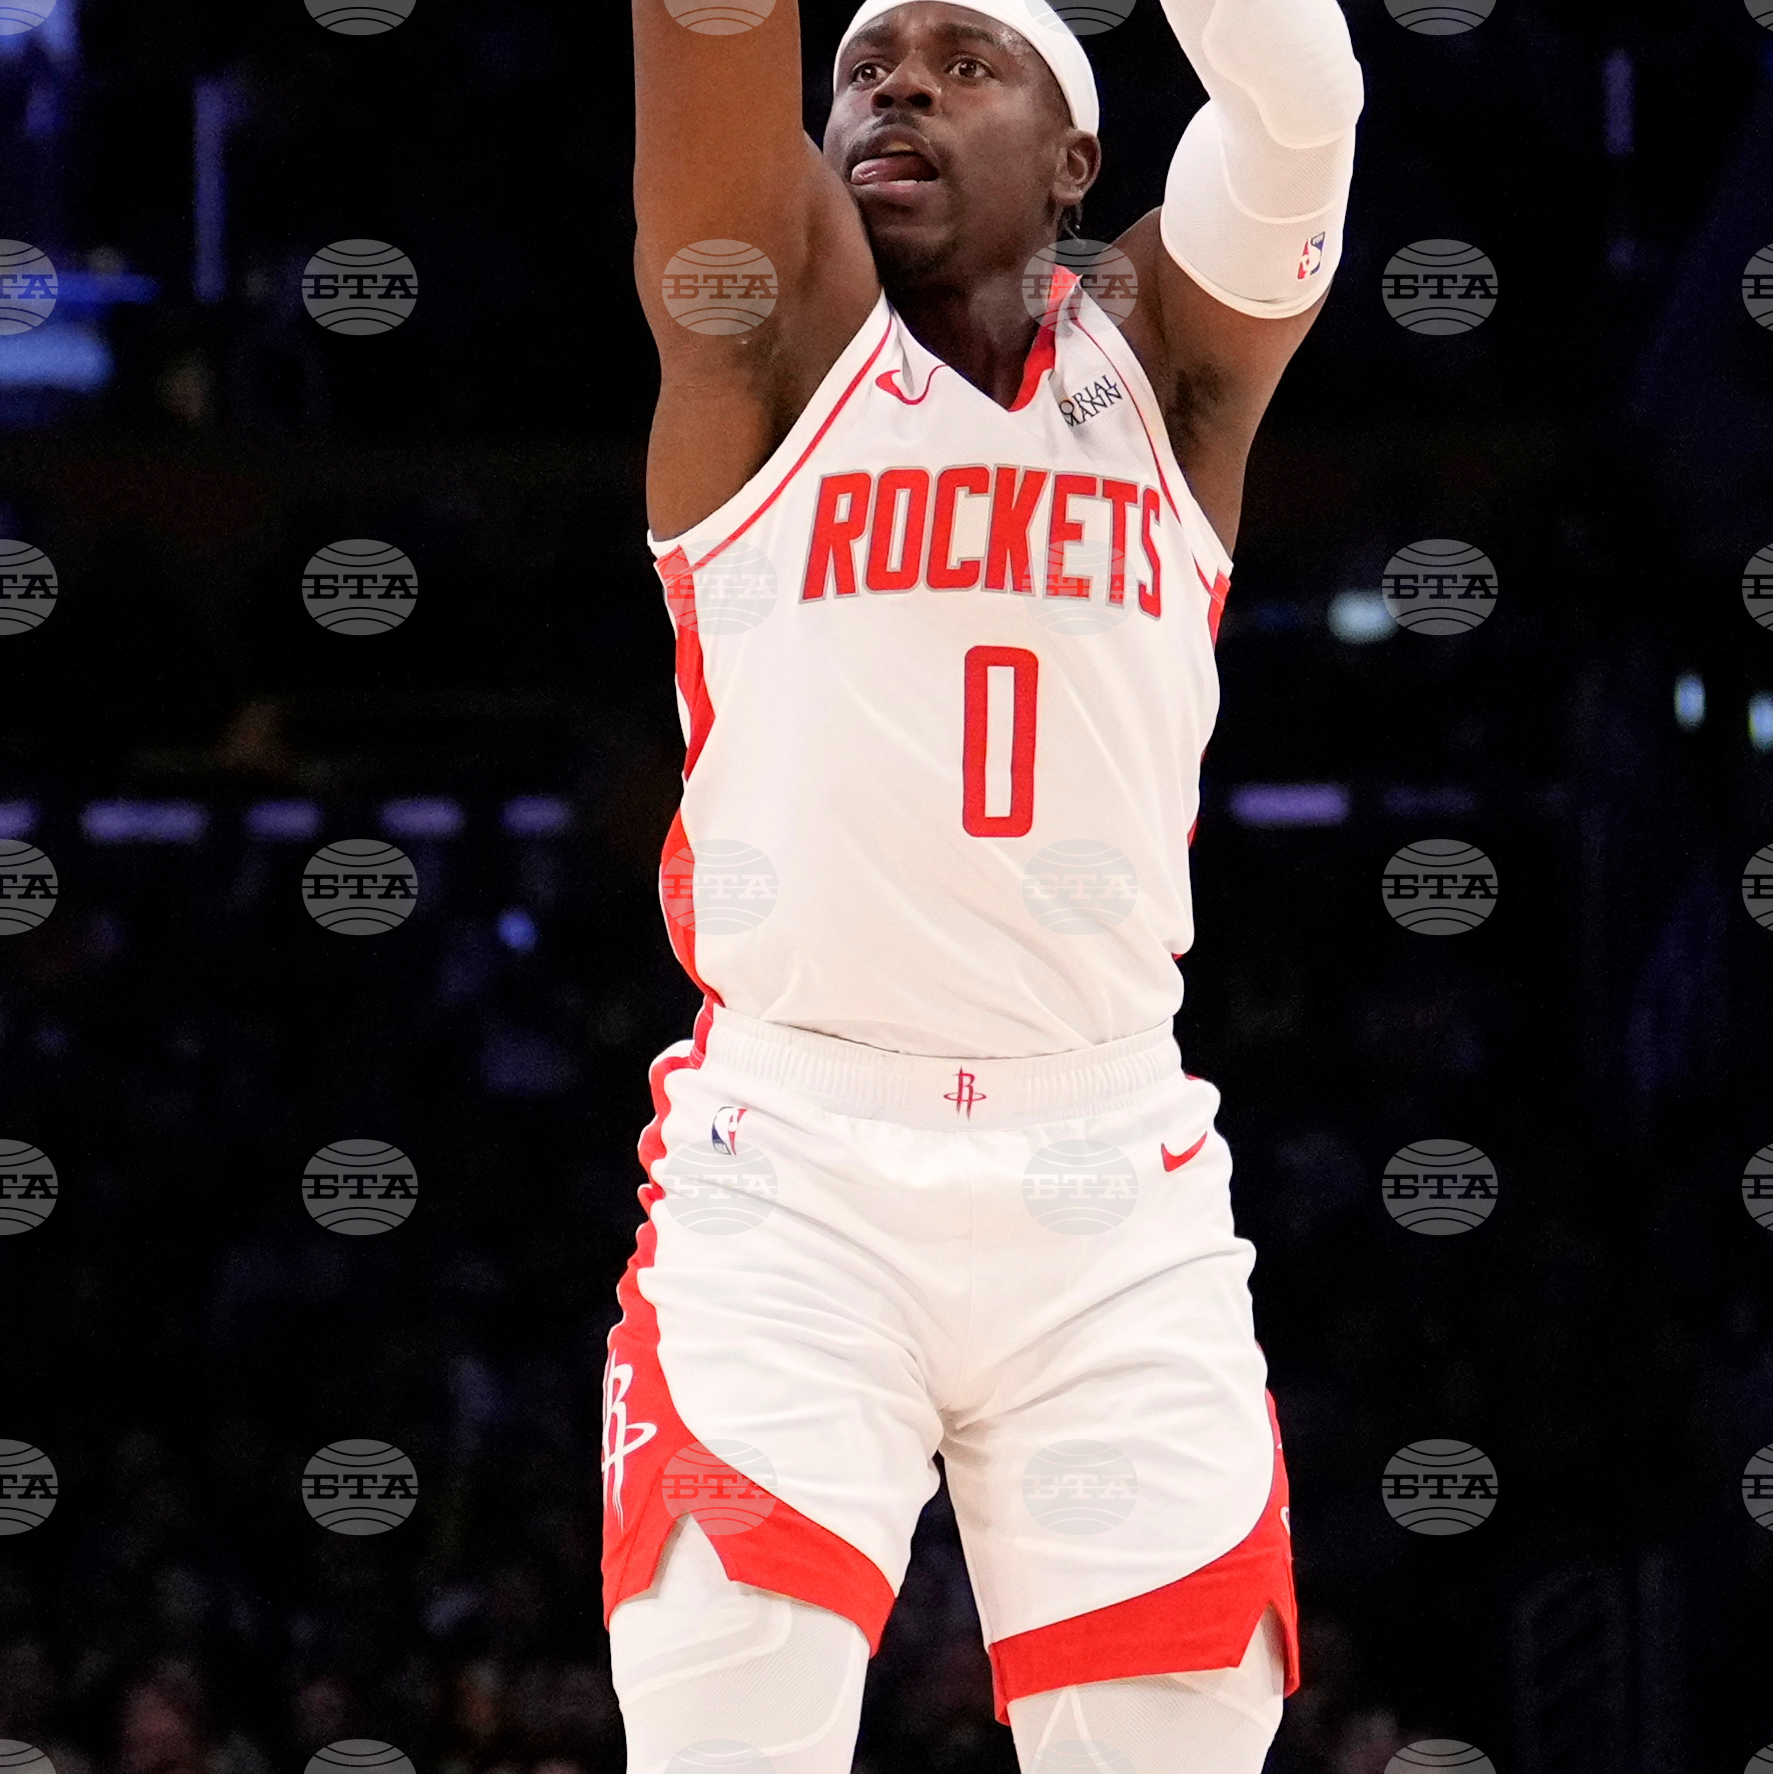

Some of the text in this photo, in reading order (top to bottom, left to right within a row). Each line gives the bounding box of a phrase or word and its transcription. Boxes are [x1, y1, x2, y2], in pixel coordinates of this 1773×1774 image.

[1059, 374, 1118, 416] ORIAL
[798, 464, 1162, 621] ROCKETS
[962, 645, 1038, 838] 0
